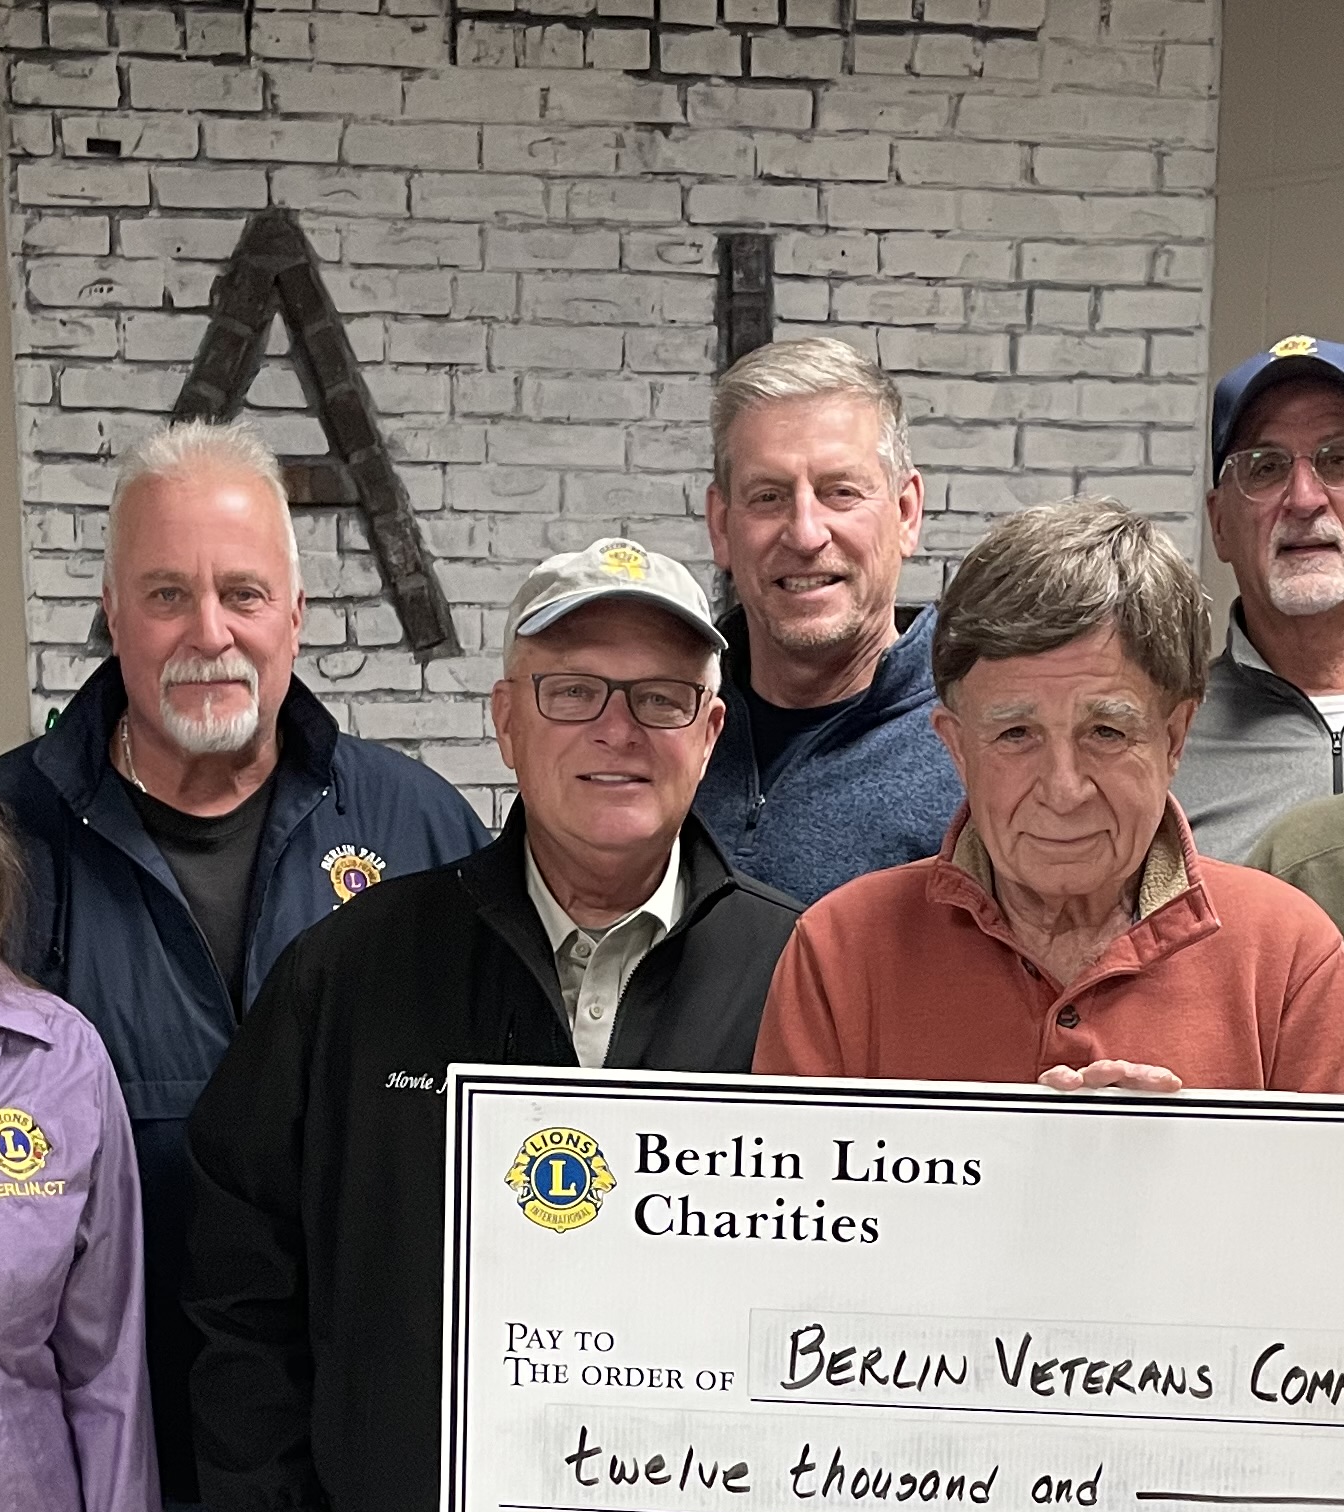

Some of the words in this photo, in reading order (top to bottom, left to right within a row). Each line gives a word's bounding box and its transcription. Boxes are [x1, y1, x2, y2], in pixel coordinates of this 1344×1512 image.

[320, 844, 356, 871] BERLIN
[349, 872, 361, 888] L
[385, 1070, 434, 1090] Howie
[0, 1130, 27, 1158] L
[529, 1131, 593, 1154] LIONS
[634, 1133, 805, 1180] Berlin
[831, 1139, 983, 1187] Lions
[548, 1159, 577, 1197] L
[530, 1205, 592, 1225] INTERNATIONAL
[634, 1193, 880, 1244] Charities
[505, 1322, 563, 1354] PAY
[573, 1330, 615, 1353] TO
[503, 1356, 569, 1388] THE
[581, 1364, 685, 1391] ORDER
[695, 1370, 736, 1392] OF
[781, 1323, 968, 1392] BERLIN
[994, 1332, 1215, 1400] VETERANS
[564, 1425, 752, 1494] twelve
[790, 1443, 999, 1505] thousand
[1032, 1465, 1102, 1507] and
